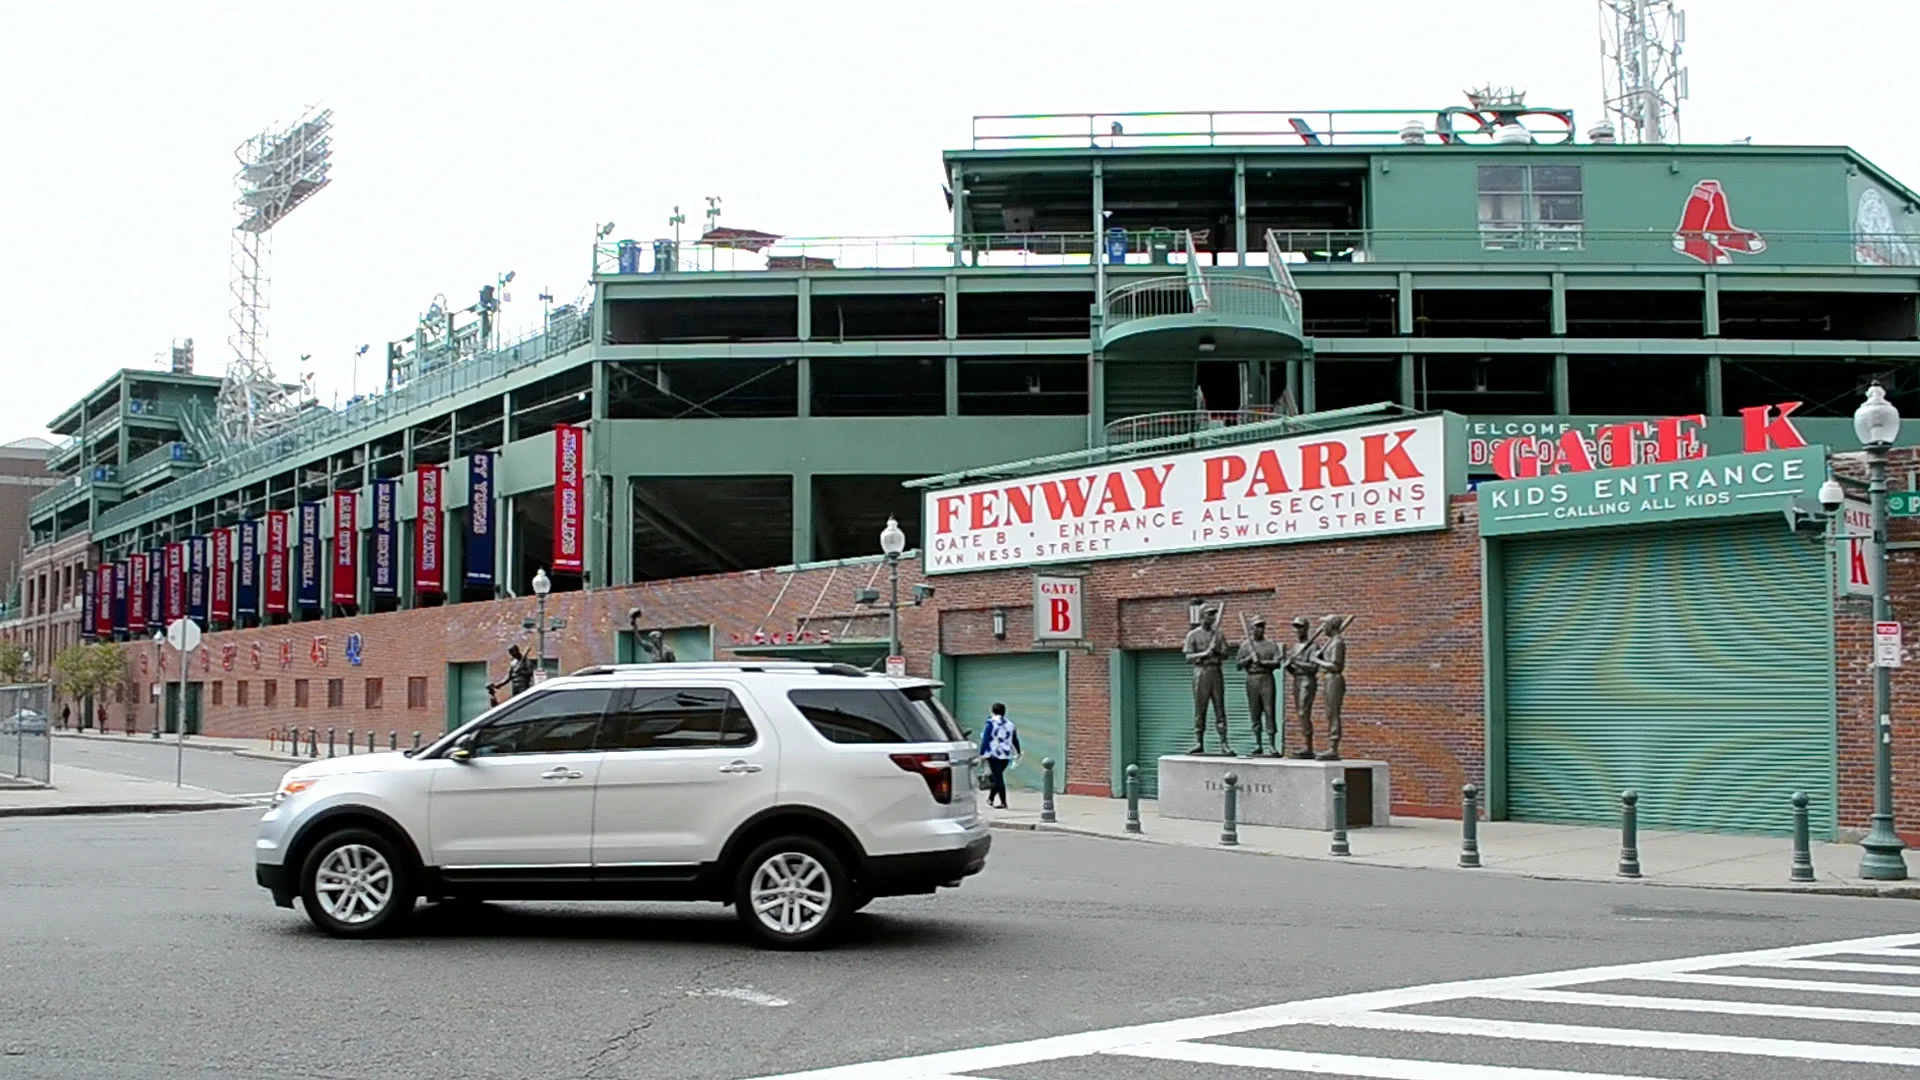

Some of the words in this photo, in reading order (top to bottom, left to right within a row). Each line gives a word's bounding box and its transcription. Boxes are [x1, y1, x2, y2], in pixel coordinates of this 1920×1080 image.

[1466, 423, 1571, 435] ELCOME
[1492, 412, 1708, 480] GATE
[1739, 401, 1808, 454] K
[935, 463, 1175, 533] FENWAY
[1202, 428, 1424, 502] PARK
[1492, 484, 1567, 509] KIDS
[1595, 459, 1805, 498] ENTRANCE
[935, 535, 982, 551] GATE
[997, 532, 1006, 545] B
[1059, 511, 1184, 538] ENTRANCE
[1202, 505, 1248, 522] ALL
[1270, 484, 1425, 516] SECTIONS
[1554, 500, 1631, 519] CALLING
[1640, 498, 1676, 511] ALL
[1685, 491, 1730, 507] KIDS
[1844, 510, 1872, 529] GATE
[934, 554, 964, 566] VAN
[977, 548, 1022, 560] NESS
[1036, 538, 1112, 556] STREET
[1192, 520, 1297, 541] IPSWICH
[1319, 507, 1425, 529] STREET
[1849, 531, 1870, 586] K
[1041, 583, 1078, 595] GATE
[1049, 598, 1071, 633] B
[309, 635, 328, 667] 45
